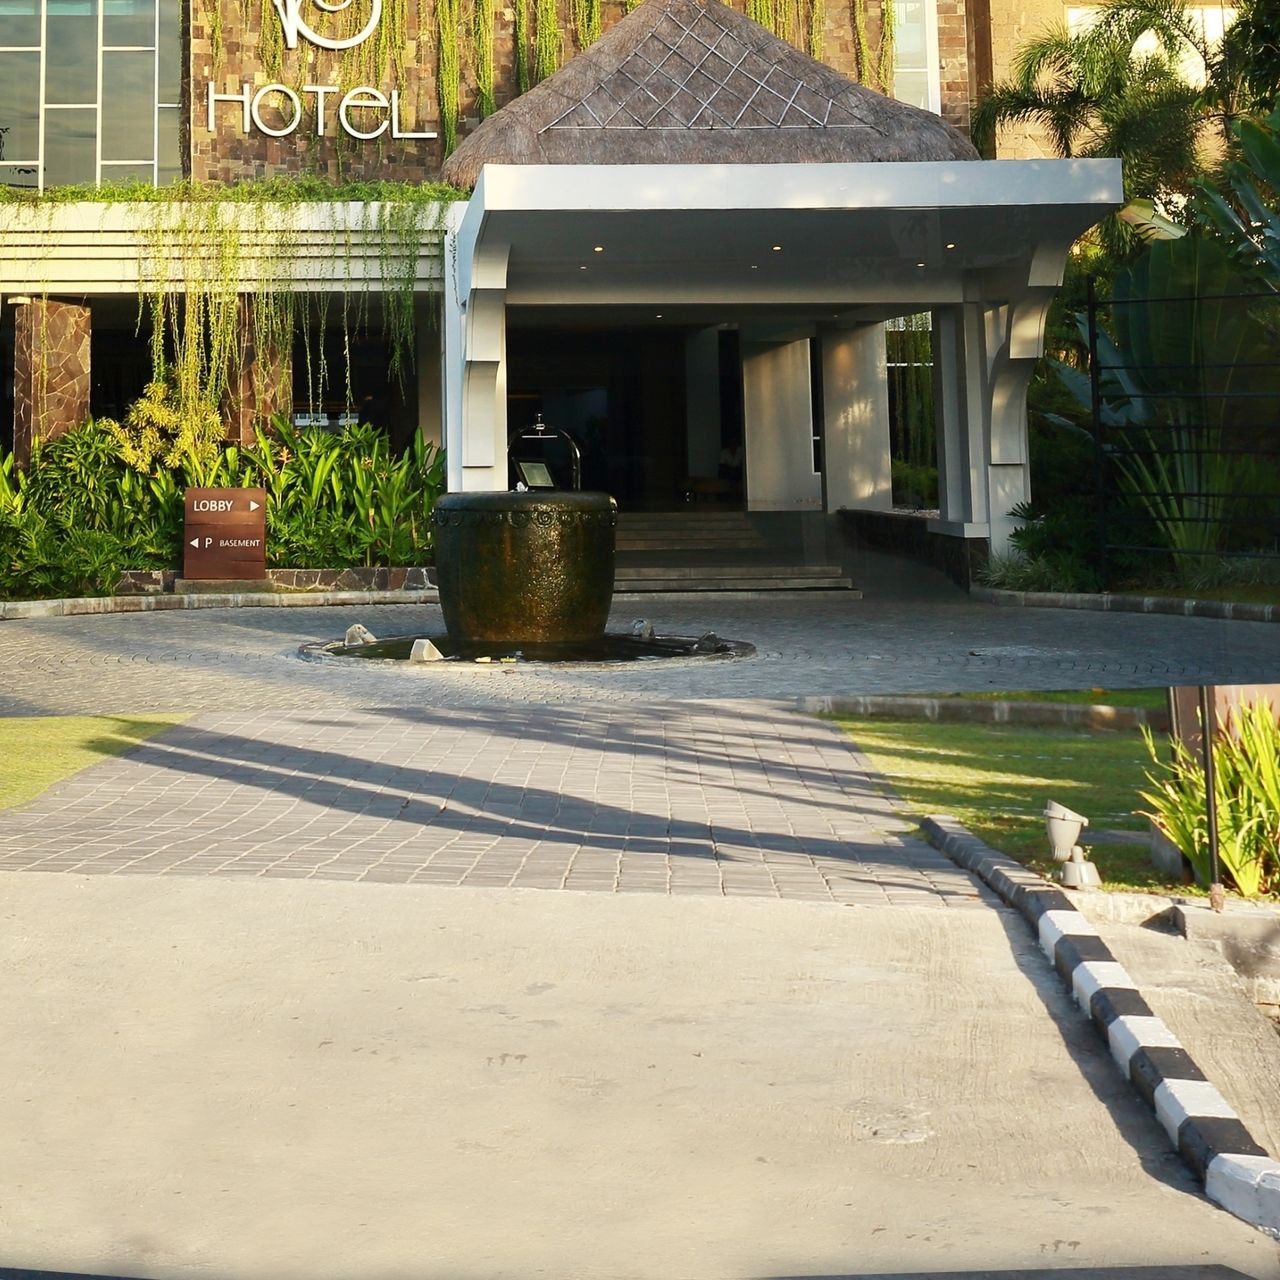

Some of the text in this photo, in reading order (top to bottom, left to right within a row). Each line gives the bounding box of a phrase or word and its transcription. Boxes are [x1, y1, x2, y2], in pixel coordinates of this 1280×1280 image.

[193, 500, 233, 512] LOBBY
[205, 537, 261, 549] P BASEMENT
